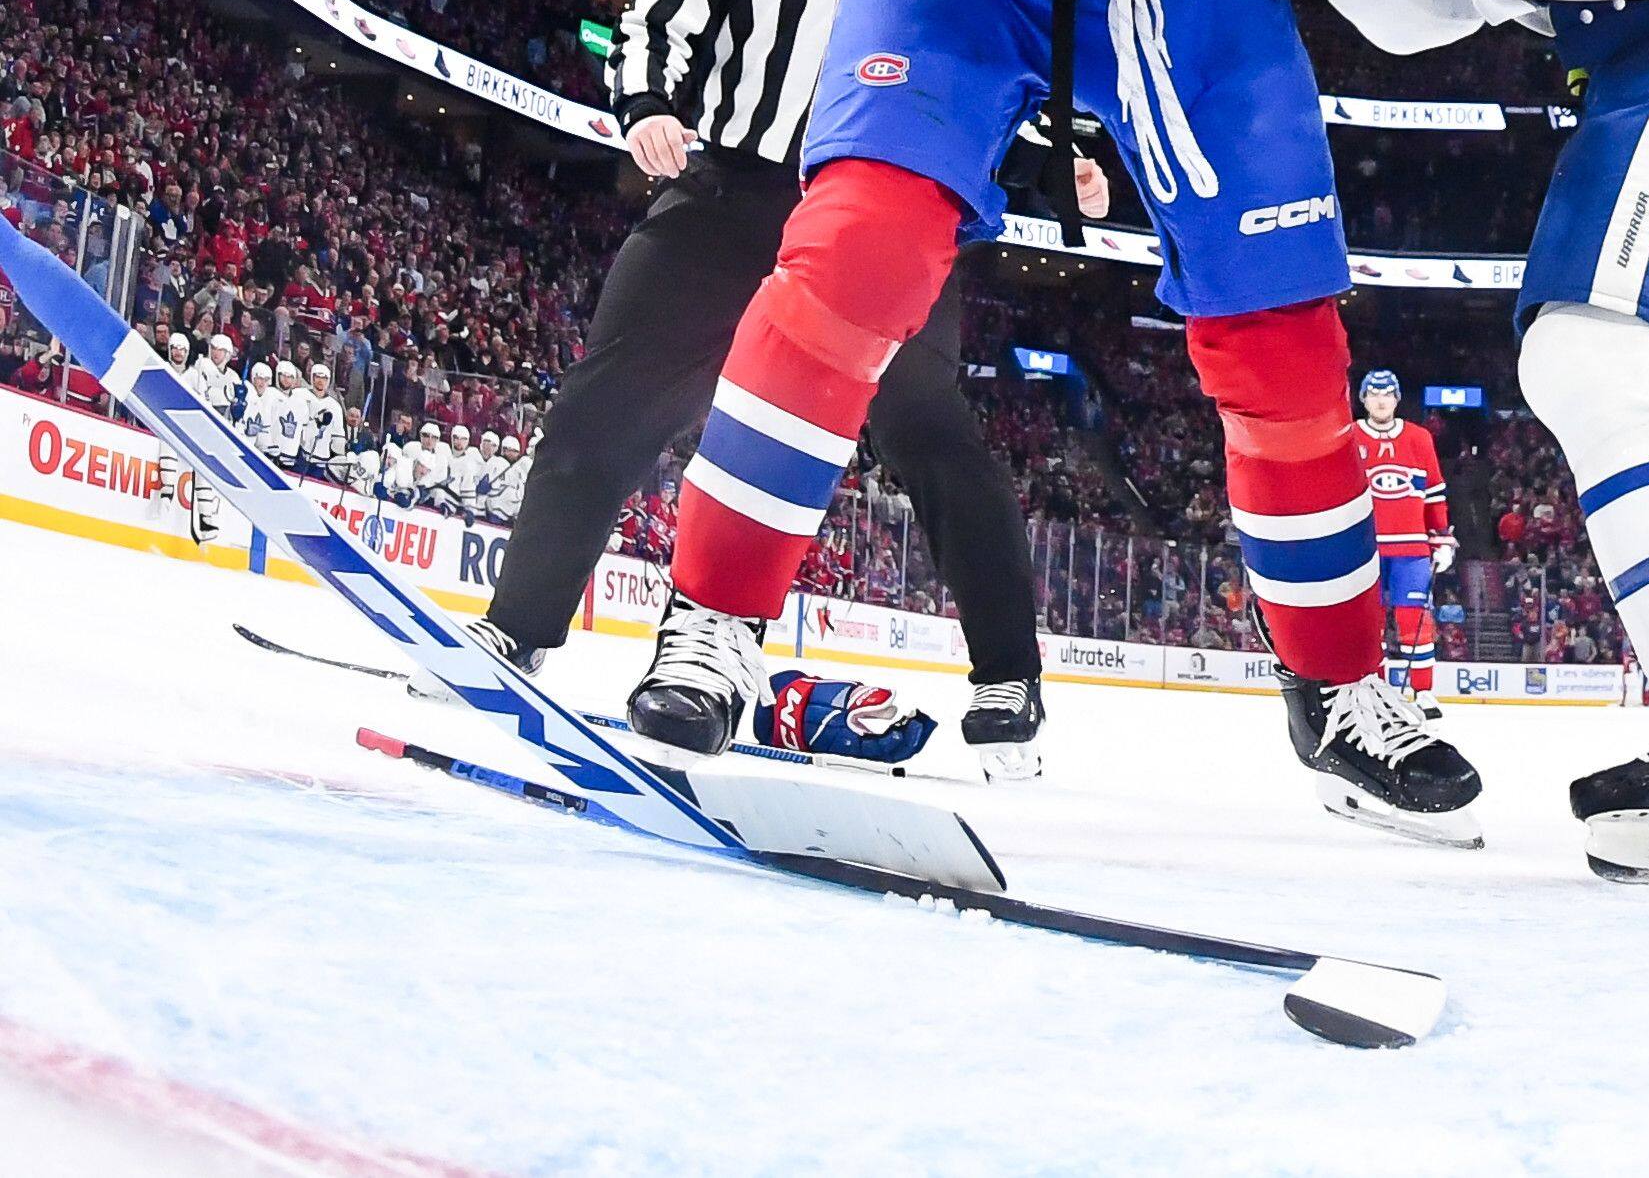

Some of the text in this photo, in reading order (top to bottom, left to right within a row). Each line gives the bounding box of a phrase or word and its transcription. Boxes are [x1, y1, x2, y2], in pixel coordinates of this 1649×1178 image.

[466, 64, 563, 124] BIRKENSTOCK
[1373, 105, 1486, 124] BIRKENSTOCK
[1239, 193, 1337, 236] CCM
[1616, 190, 1649, 269] WARRIOR
[28, 420, 193, 511] OZEMPC
[1060, 640, 1126, 669] ultratek
[1457, 667, 1499, 693] Bell
